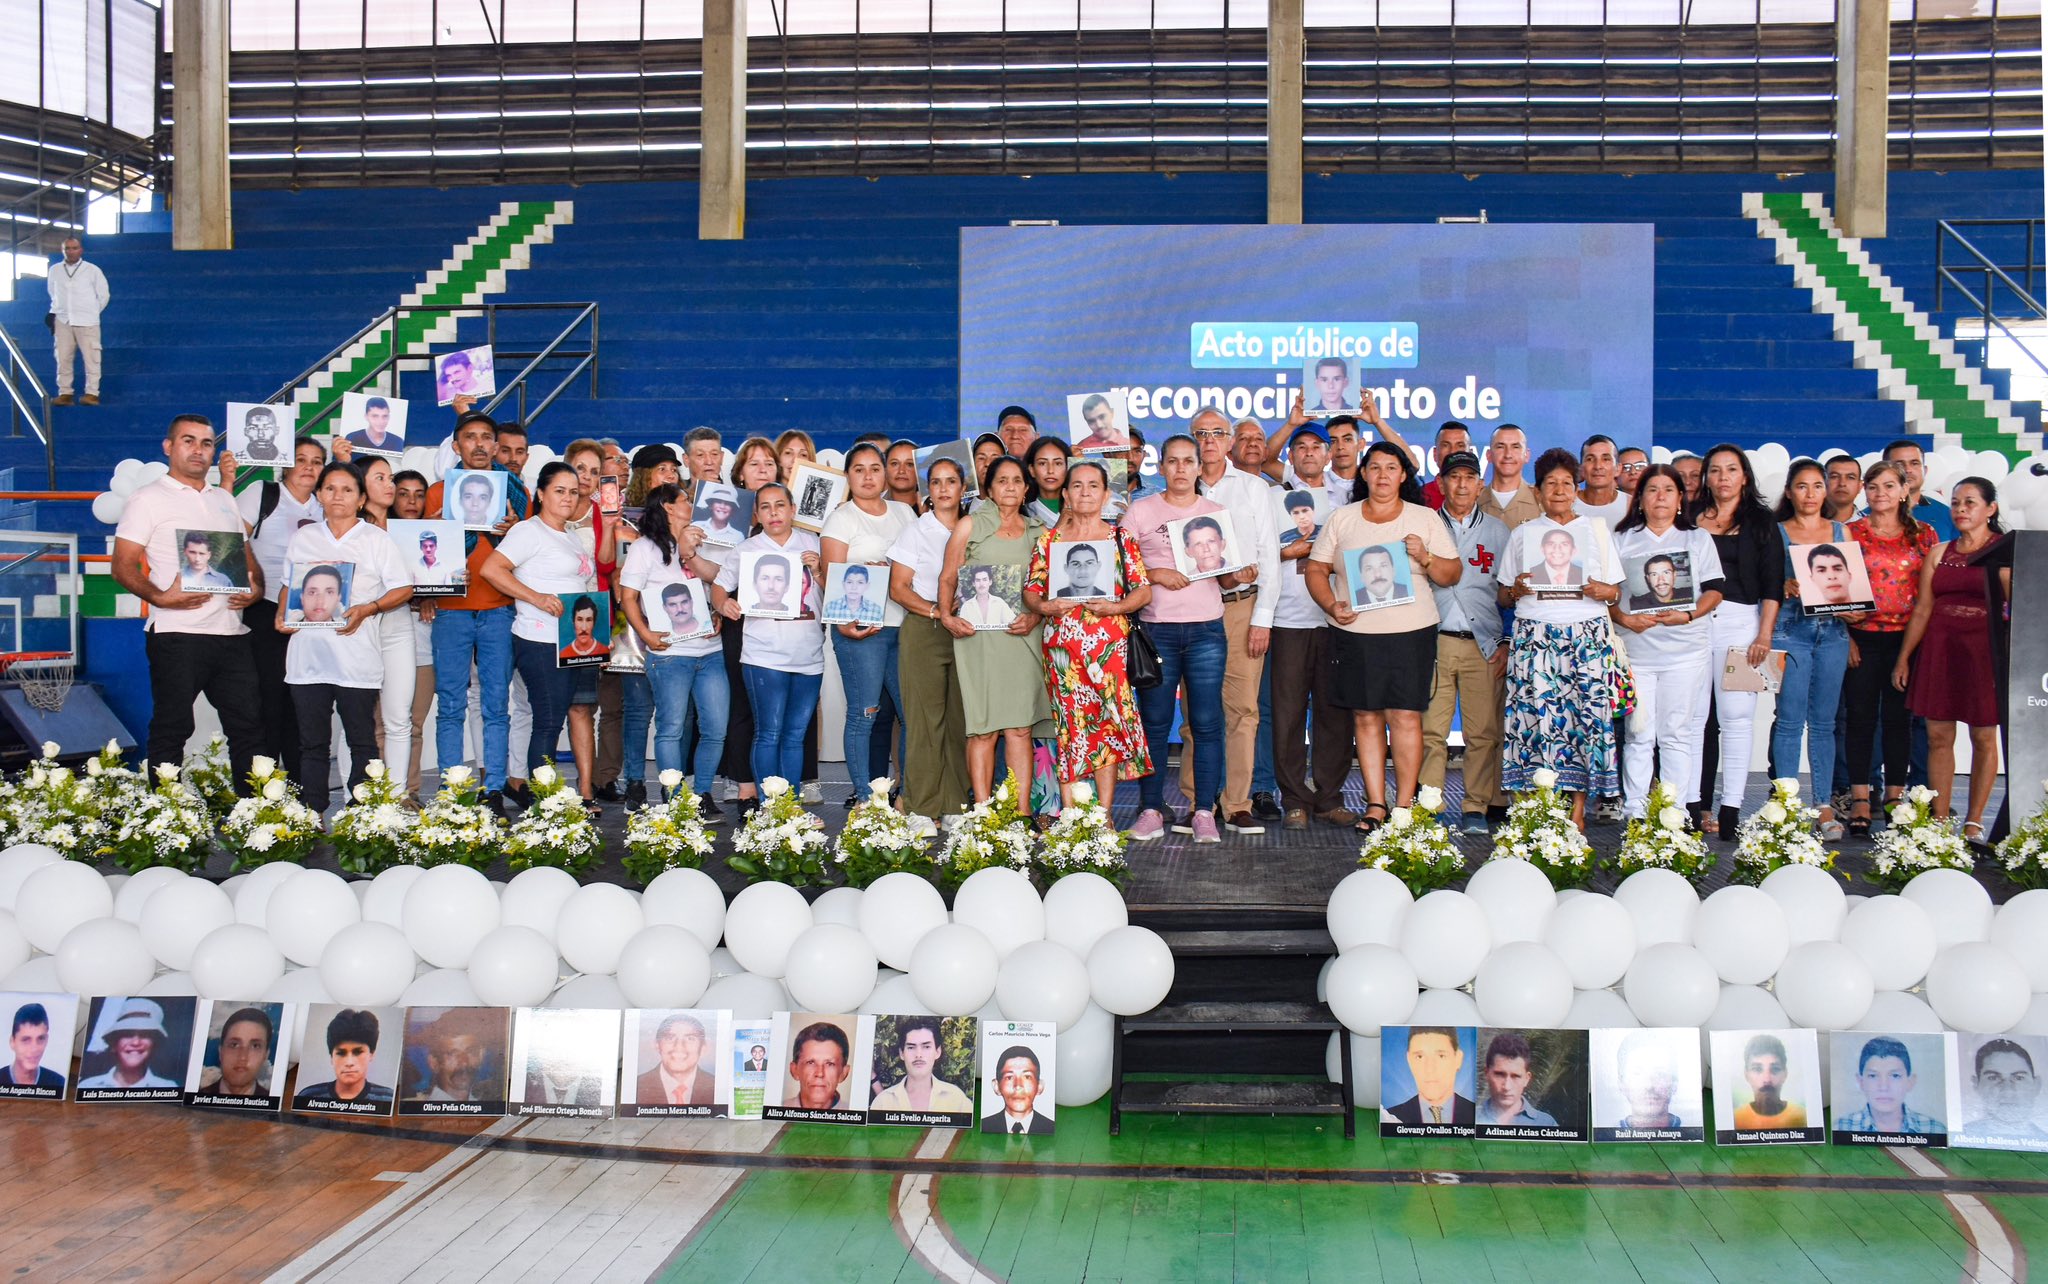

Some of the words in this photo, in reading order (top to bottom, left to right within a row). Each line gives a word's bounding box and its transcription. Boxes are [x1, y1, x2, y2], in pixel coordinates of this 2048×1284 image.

[1197, 328, 1263, 358] Acto
[1272, 326, 1372, 365] público
[1380, 328, 1413, 358] de
[1449, 376, 1501, 419] de
[10, 1086, 36, 1096] Angarita
[82, 1090, 98, 1099] Luis
[124, 1090, 151, 1098] Ascanio
[151, 1090, 179, 1098] Ascanio
[192, 1095, 212, 1105] Javier
[212, 1096, 244, 1106] Barrientos
[244, 1097, 270, 1107] Bautista
[308, 1099, 328, 1108] Alvaro
[328, 1100, 348, 1110] Chogo
[349, 1101, 376, 1111] Angarita
[423, 1103, 441, 1112] Olivo
[442, 1103, 459, 1112] Peña
[459, 1104, 482, 1113] Ortega
[518, 1105, 533, 1115] José
[533, 1105, 555, 1114] Eliecer
[556, 1107, 578, 1117] Ortega
[579, 1107, 602, 1116] Boneth
[636, 1106, 668, 1116] Jonathan
[669, 1107, 687, 1115] Meza
[688, 1106, 711, 1115] Badillo
[767, 1108, 783, 1117] Aliro
[783, 1109, 809, 1118] Alfonso
[809, 1110, 836, 1120] Sánchez
[837, 1112, 862, 1121] Salcedo
[885, 1113, 900, 1121] Luis
[900, 1113, 921, 1121] Evelio
[921, 1114, 951, 1124] Angarita
[1396, 1126, 1425, 1135] Giovany
[1426, 1126, 1452, 1135] Ovallos
[1453, 1126, 1475, 1137] Trigos
[1485, 1127, 1517, 1136] Adinael
[1517, 1128, 1539, 1137] Arias
[1540, 1128, 1579, 1138] Cárdenas
[1615, 1130, 1631, 1138] Raúl
[1632, 1130, 1656, 1139] Amaya
[1657, 1130, 1682, 1139] Amaya
[1736, 1132, 1759, 1141] Ismael
[1759, 1131, 1789, 1141] Quintero
[1852, 1134, 1876, 1143] Hector
[1876, 1135, 1906, 1144] Antonio
[1906, 1136, 1928, 1144] Rubio
